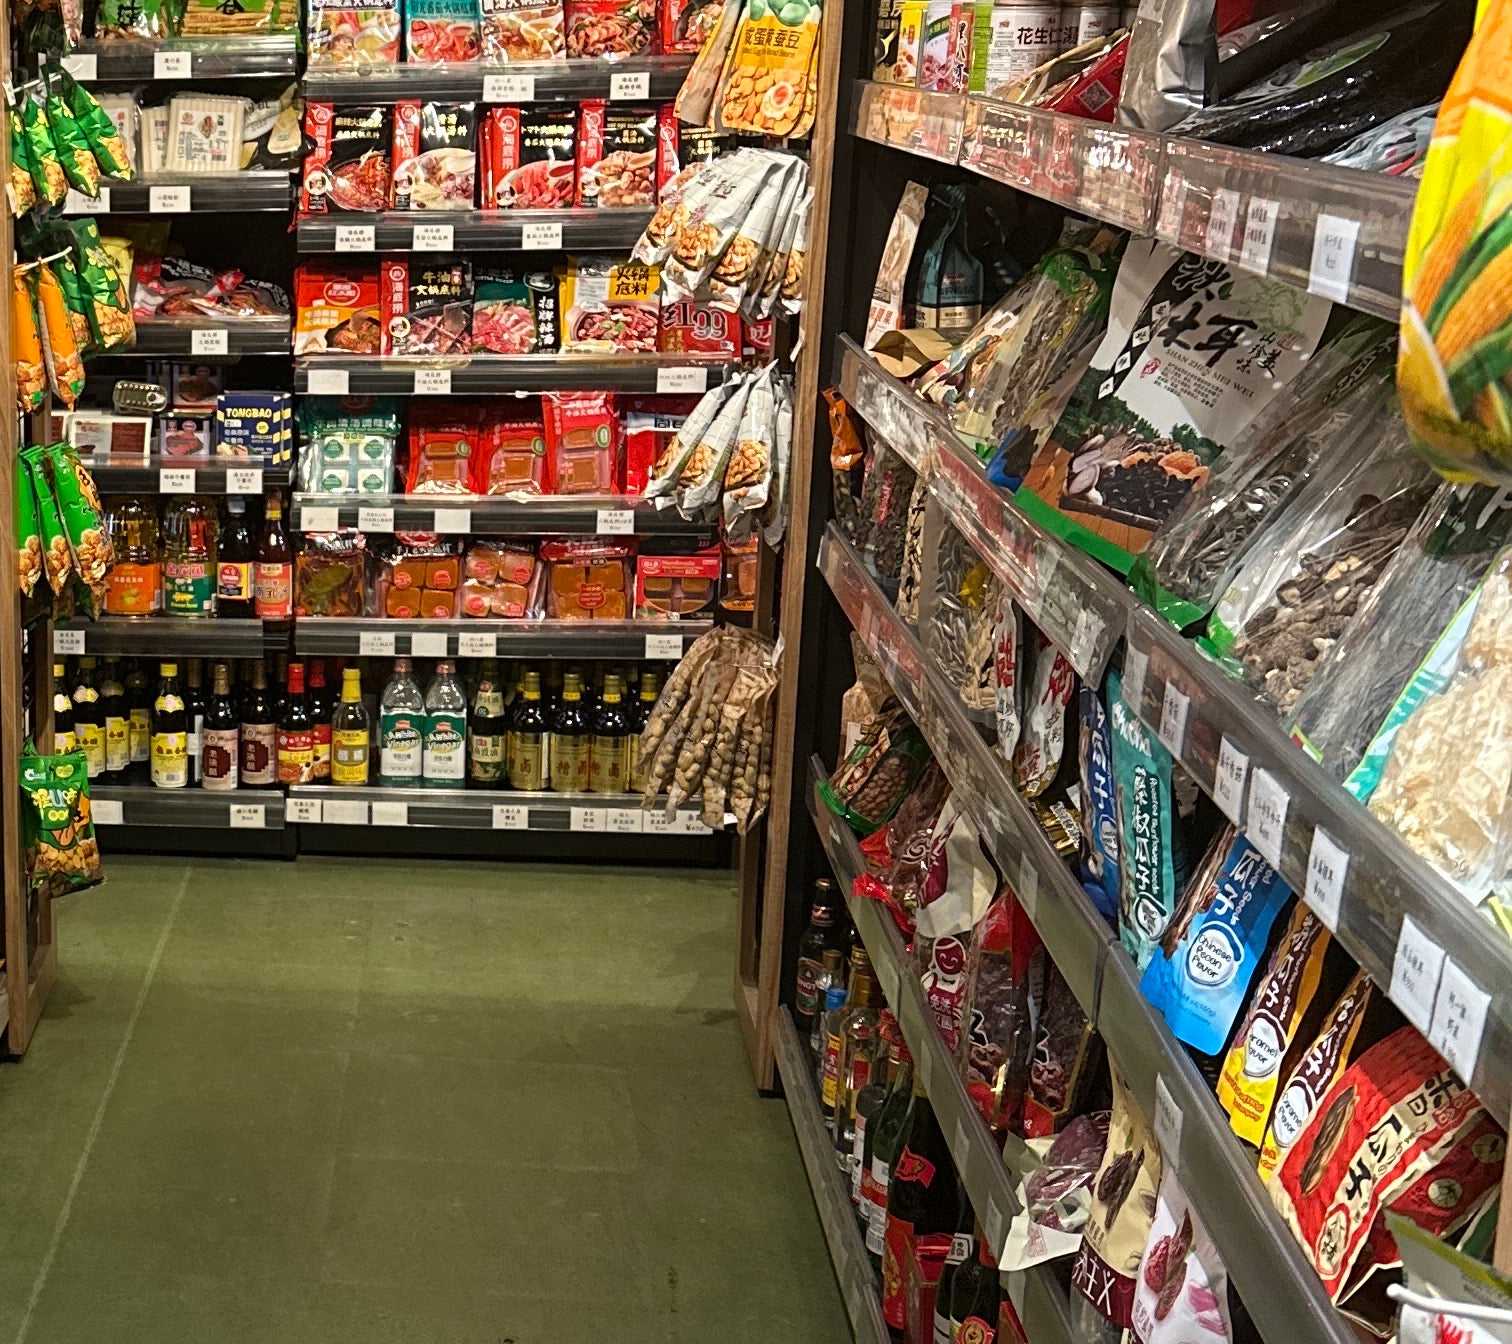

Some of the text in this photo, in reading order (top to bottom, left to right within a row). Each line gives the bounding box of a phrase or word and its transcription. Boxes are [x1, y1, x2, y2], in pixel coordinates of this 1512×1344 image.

[501, 134, 515, 171] 海底捞
[422, 269, 452, 284] 牛油
[615, 265, 651, 282] 火锅
[391, 281, 405, 315] 海底捞
[415, 283, 462, 297] 火锅底料
[614, 281, 649, 297] 底料
[1159, 316, 1256, 352] 木耳
[1164, 347, 1192, 365] SHAN
[1192, 359, 1218, 377] ZHEN
[224, 406, 274, 422] TONGBAO
[1196, 945, 1224, 971] Pecan
[1197, 931, 1232, 964] Chinese
[1191, 954, 1220, 979] Flavor
[1249, 1031, 1282, 1059] aramel
